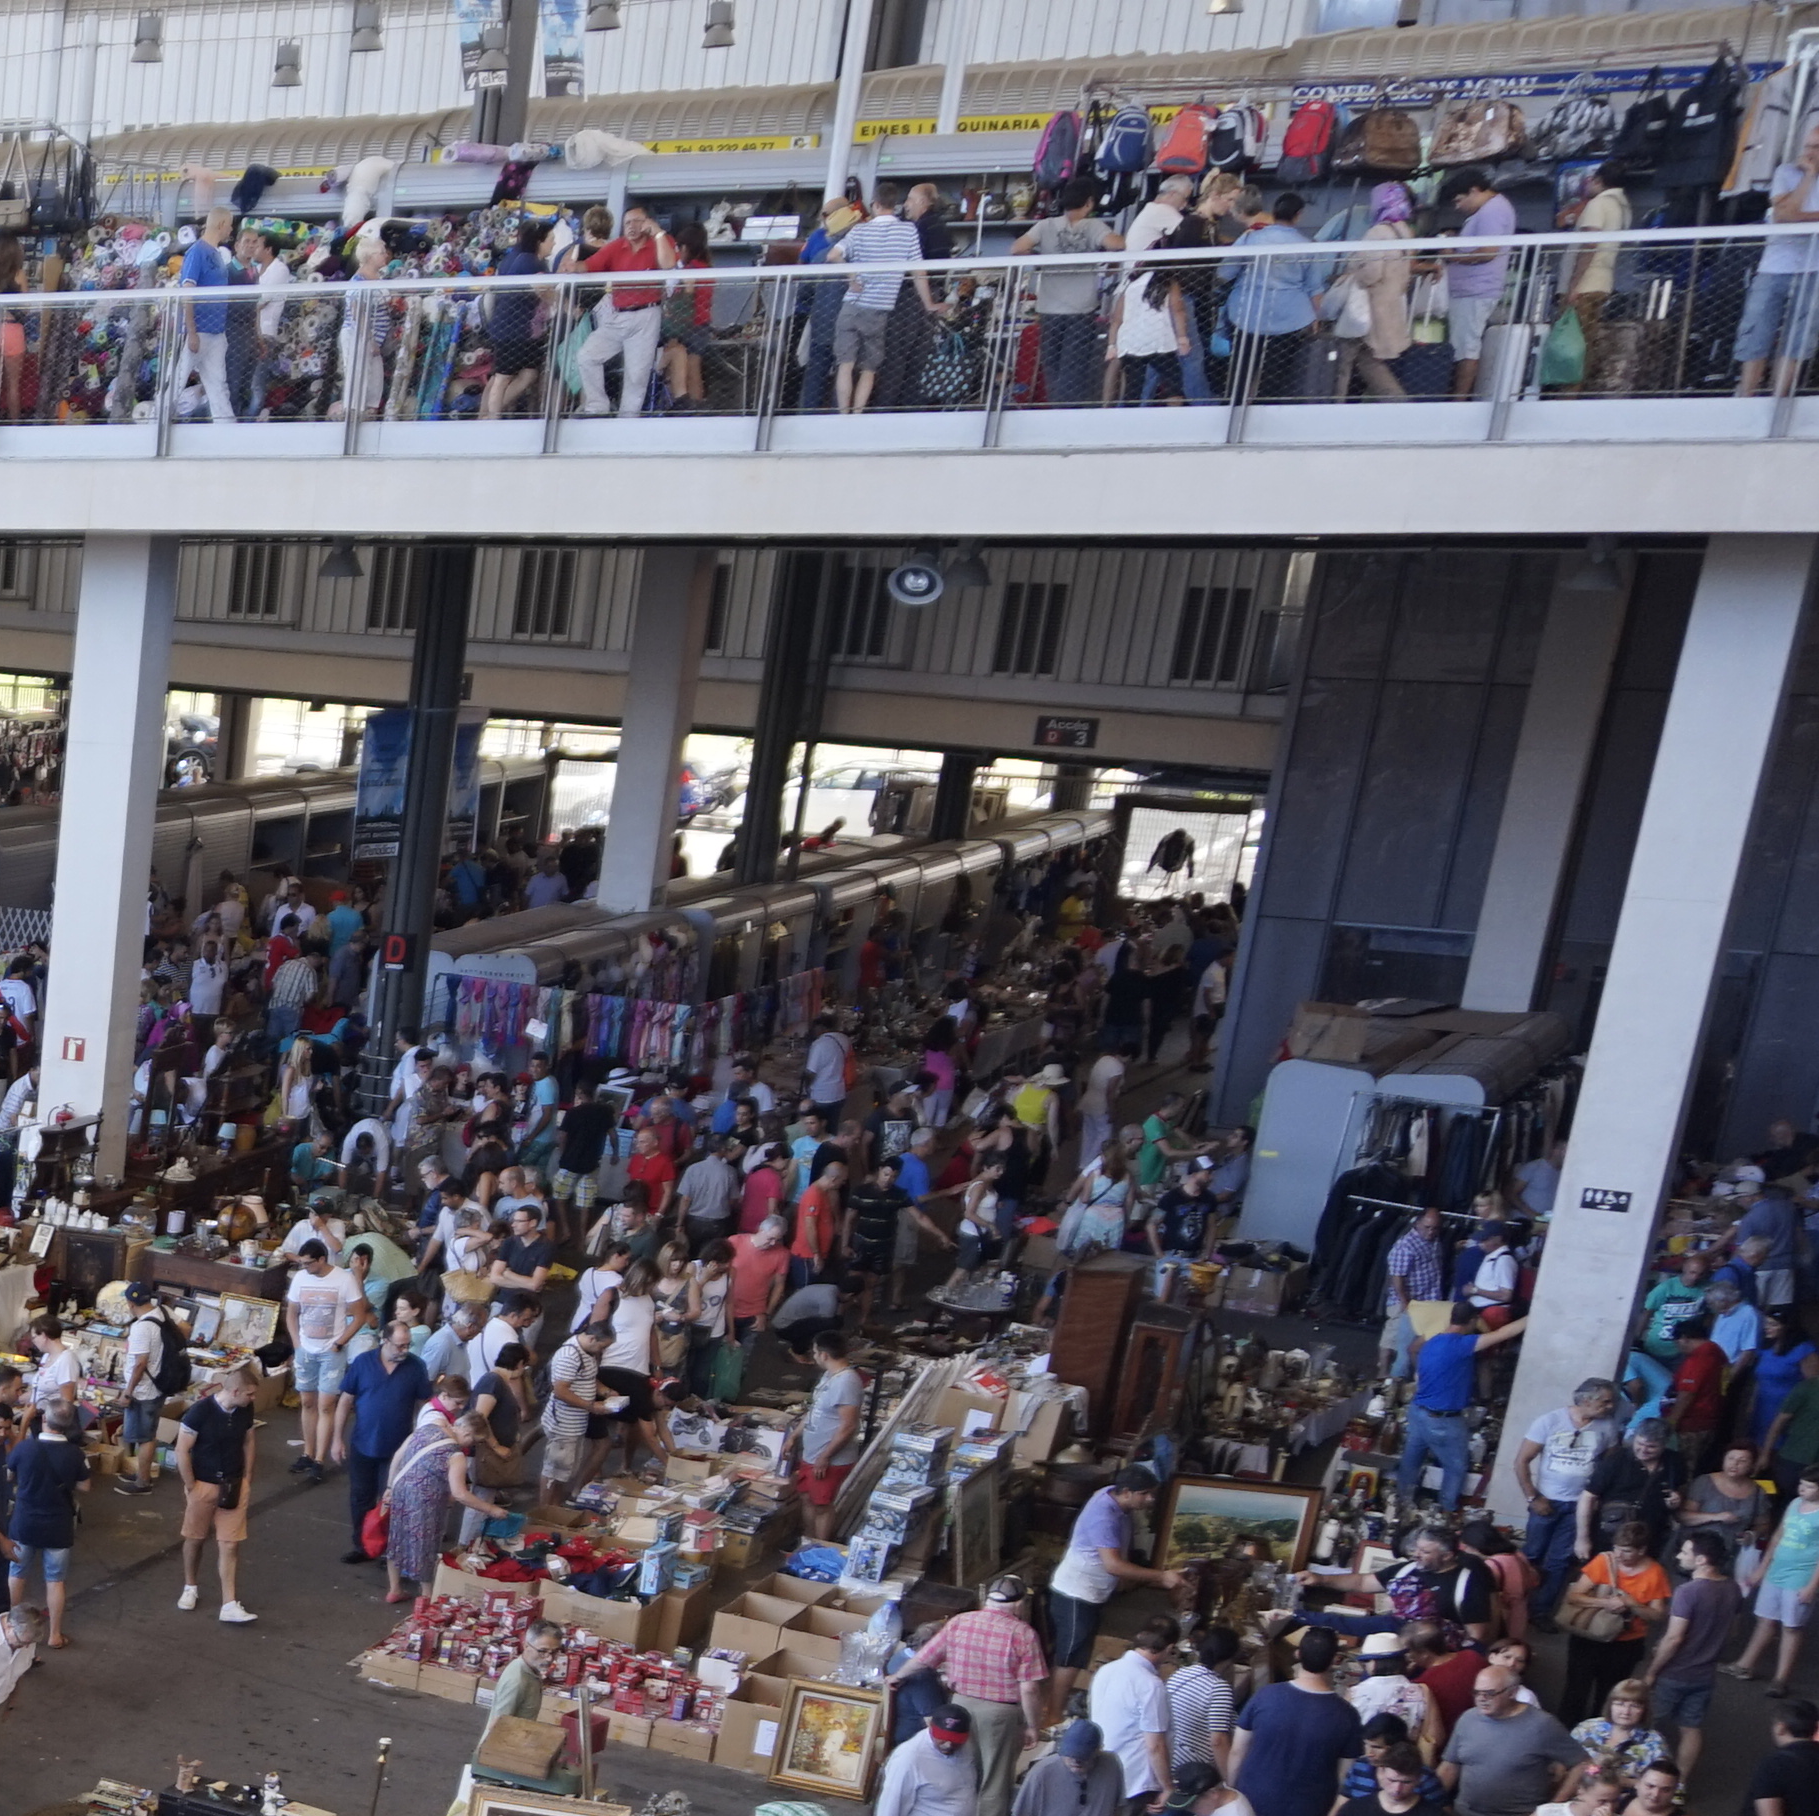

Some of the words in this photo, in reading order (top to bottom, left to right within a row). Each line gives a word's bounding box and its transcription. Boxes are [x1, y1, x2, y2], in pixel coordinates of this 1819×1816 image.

[860, 124, 910, 136] EINES
[930, 118, 1041, 134] MQUINARIA
[1074, 731, 1087, 745] 3
[385, 935, 406, 964] D
